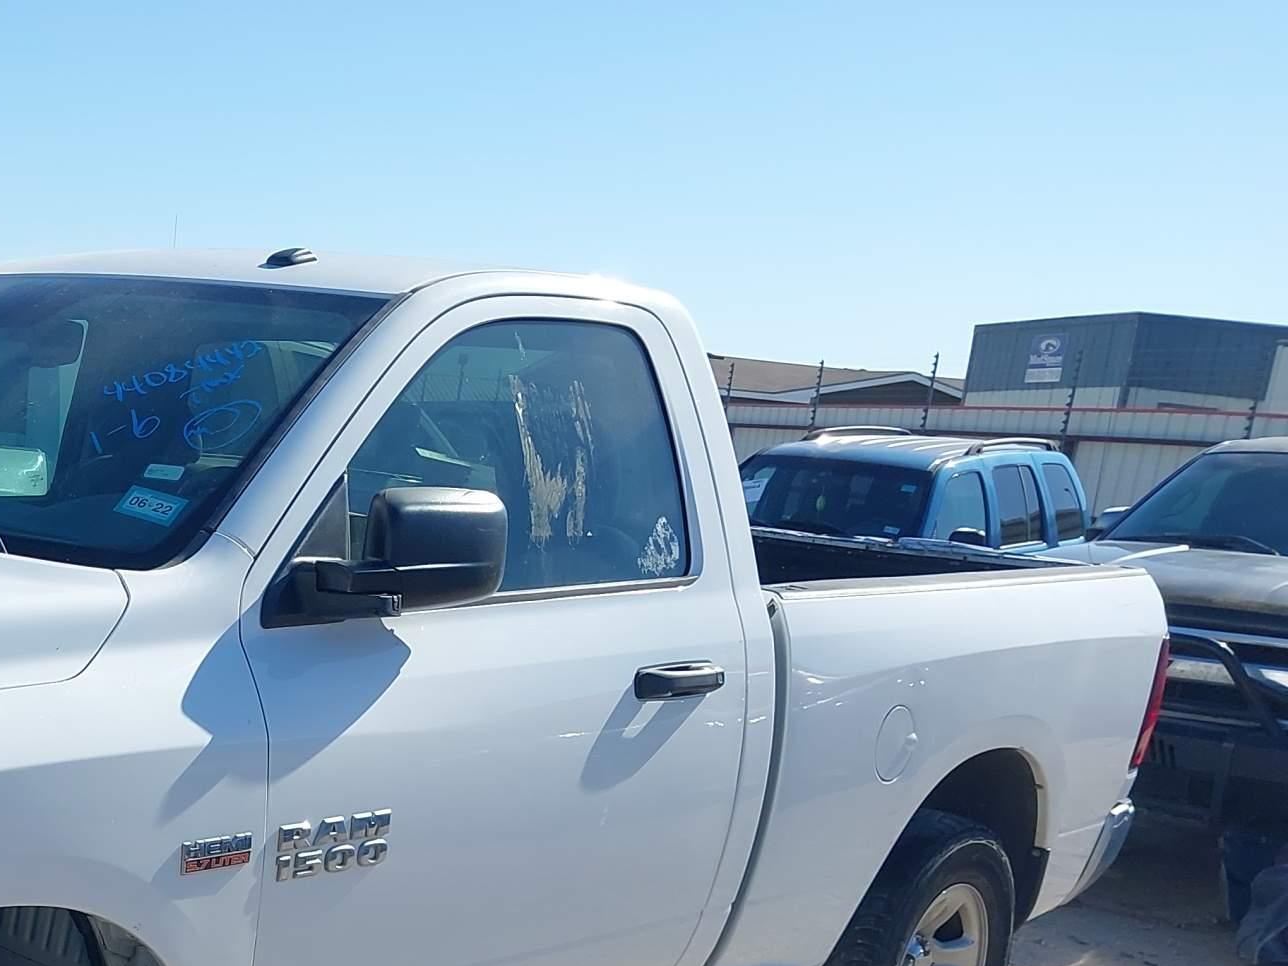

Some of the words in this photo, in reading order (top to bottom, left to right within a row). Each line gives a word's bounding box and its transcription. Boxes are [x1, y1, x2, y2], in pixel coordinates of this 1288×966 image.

[128, 496, 173, 516] 06-22
[277, 807, 392, 852] RAM
[182, 832, 253, 859] HEMI
[210, 853, 250, 869] LITER
[275, 838, 389, 882] 1500
